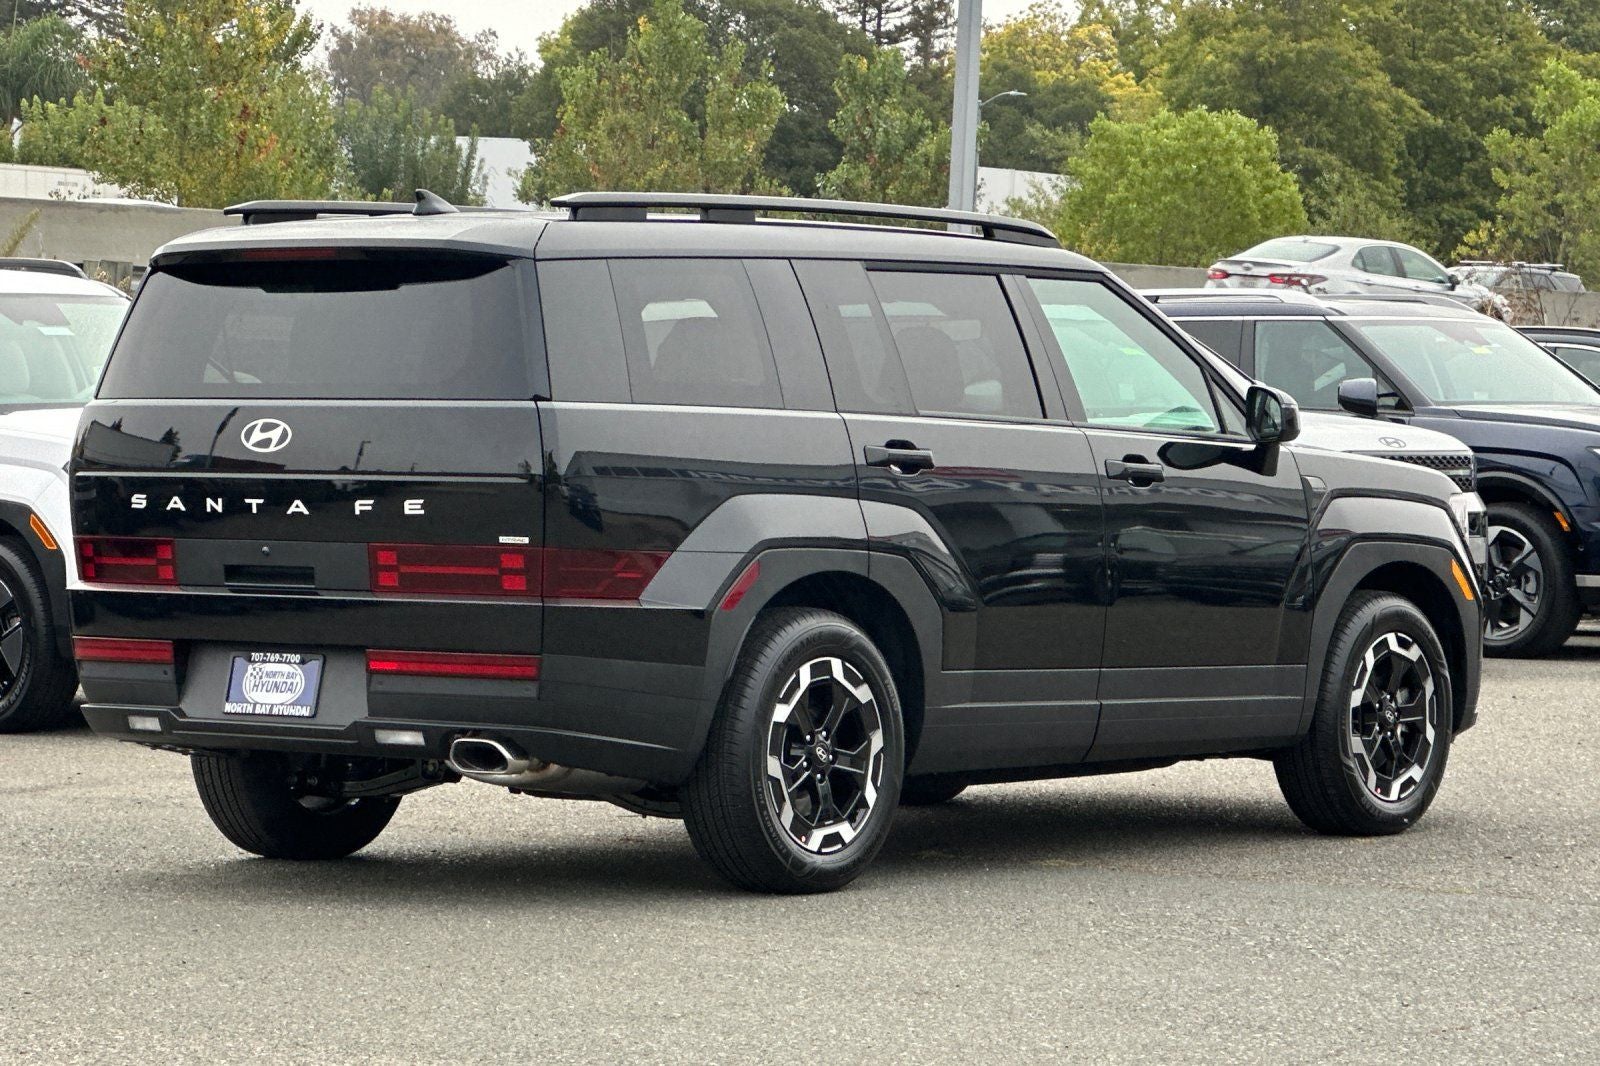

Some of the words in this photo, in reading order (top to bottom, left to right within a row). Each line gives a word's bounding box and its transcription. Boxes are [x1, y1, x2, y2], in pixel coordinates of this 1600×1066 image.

[131, 493, 310, 515] SANTA
[354, 498, 425, 516] FE
[251, 653, 300, 663] 707-769-7700
[265, 671, 286, 680] NORTH
[286, 672, 298, 680] BAY
[251, 680, 299, 694] HYUNDAI
[224, 702, 254, 714] NORTH
[255, 704, 272, 715] BAY
[272, 705, 311, 717] HYUNDAI
